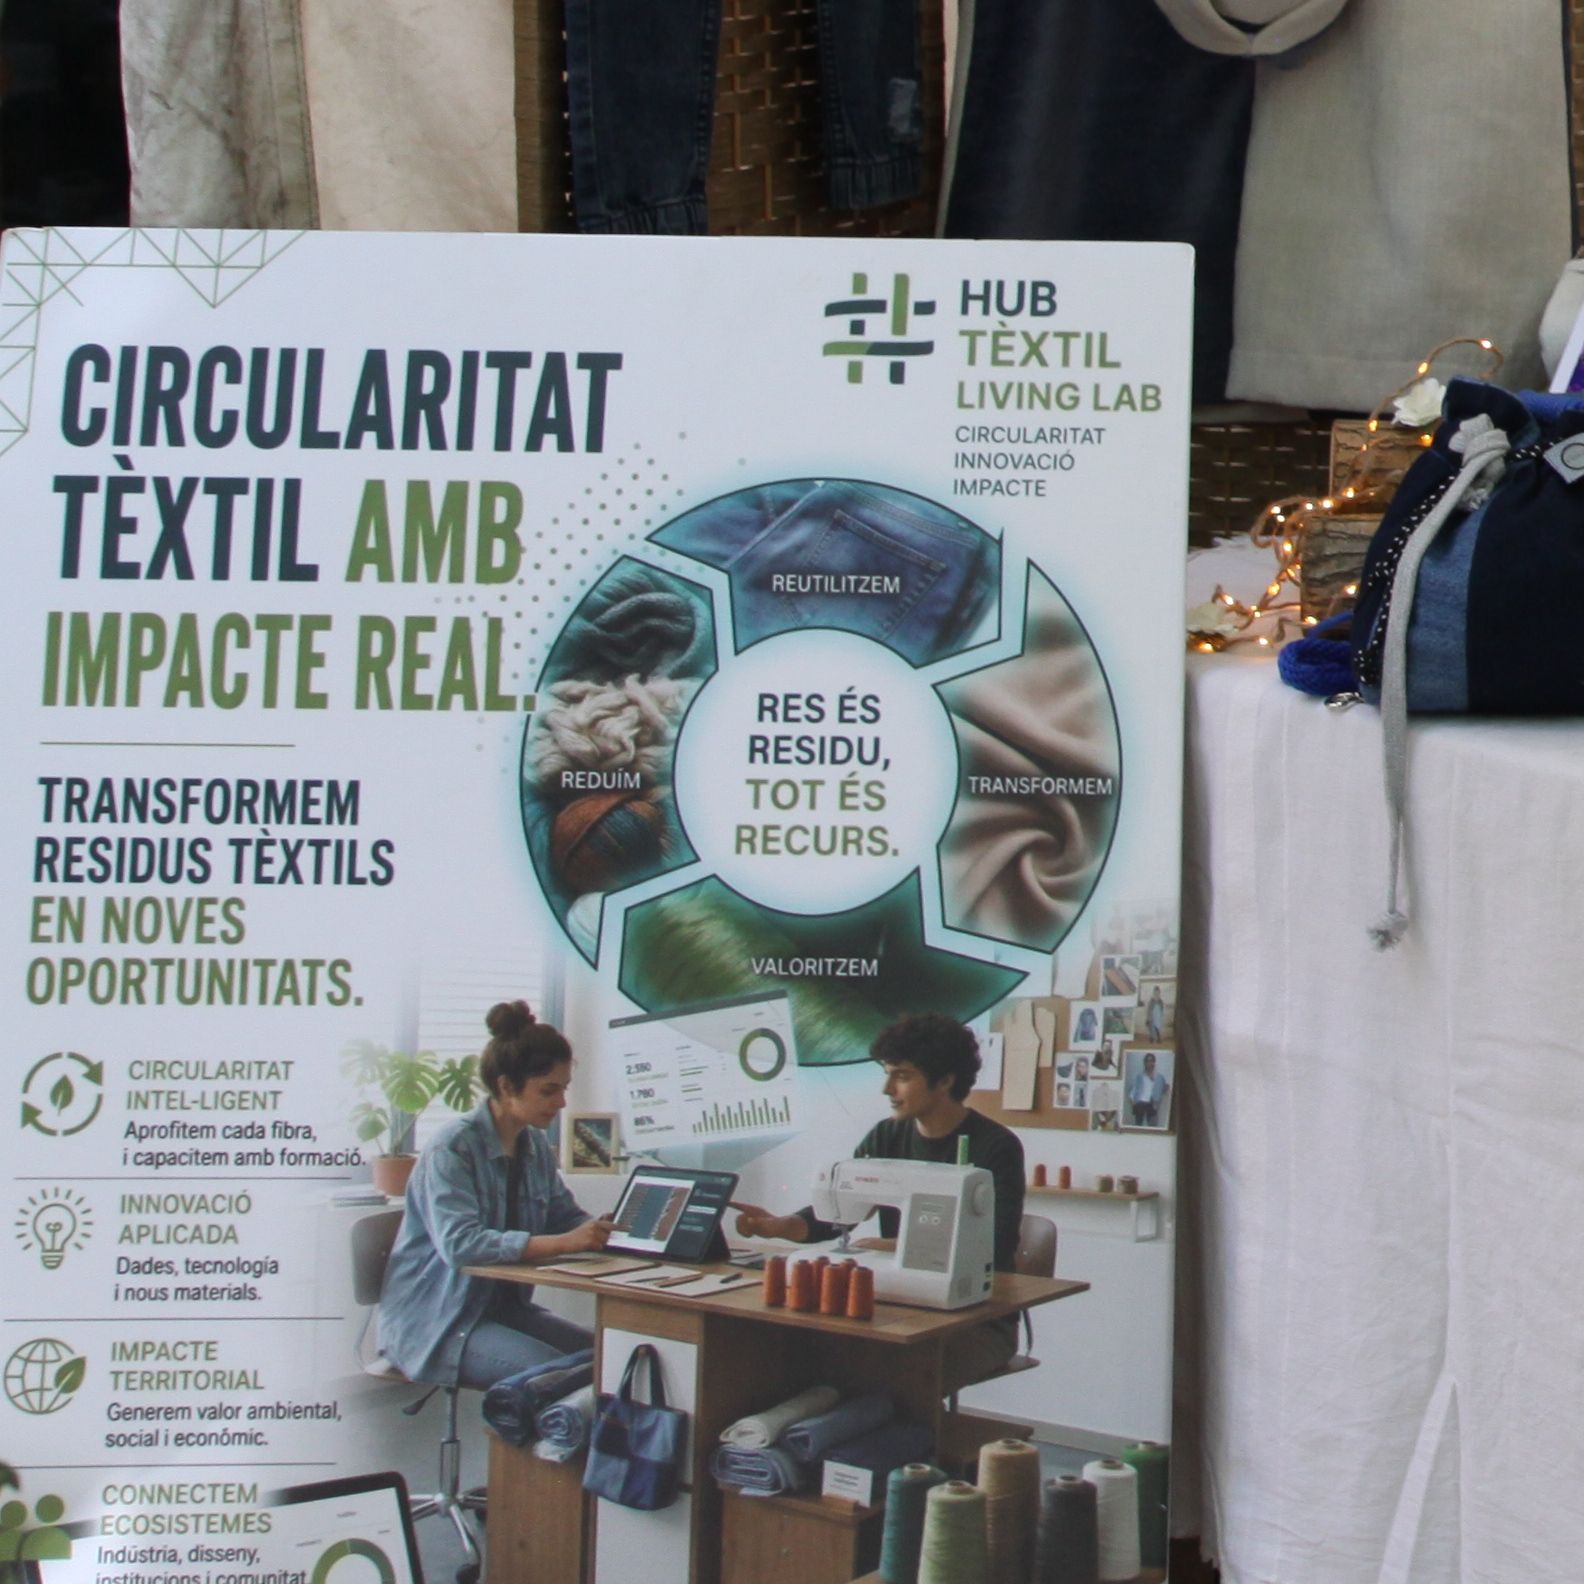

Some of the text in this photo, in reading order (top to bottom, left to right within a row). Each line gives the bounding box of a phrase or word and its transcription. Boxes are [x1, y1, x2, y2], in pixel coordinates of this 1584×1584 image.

[959, 280, 1058, 317] HUB
[957, 320, 1122, 369] TÈXTIL
[60, 343, 623, 453] CIRCULARITAT
[956, 381, 1162, 413] LIVING LAB
[954, 425, 1106, 446] CIRCULARITAT
[953, 448, 1075, 471] INNOVACIÓ
[952, 477, 1047, 498] IMPACTE
[52, 454, 524, 585] TÈXTIL AMB
[771, 573, 900, 595] REUTILITZEM
[41, 611, 536, 712] IMPACTE REAL.
[757, 686, 881, 725] RES ÉS
[747, 735, 892, 772] RESIDU,
[560, 767, 641, 790] REDUÍM
[746, 770, 886, 811] TOT ÉS
[968, 774, 1113, 797] TRANSFORMEM
[38, 776, 361, 826] TRANSFORMEM
[734, 824, 900, 858] RECURS.
[33, 828, 396, 886] RESIDUS TÈXTILS
[30, 896, 247, 945] EN NOVES
[751, 956, 879, 978] VALORITZEM
[25, 957, 364, 1007] OPORTUNITATS.
[127, 1059, 295, 1081] CIRCULARITAT
[124, 1120, 318, 1144] Aprofitem cada fibra,
[122, 1147, 367, 1169] i capacitem amb formació.
[119, 1190, 252, 1215] INNOVACIÓ
[118, 1224, 239, 1245] APLICADA
[116, 1256, 179, 1277] Dades,
[113, 1283, 262, 1302] i nous materials.
[111, 1340, 218, 1363] IMPACTE
[109, 1369, 265, 1392] TERRITORIAL
[106, 1400, 343, 1422] Generem valor ambiental,
[104, 1428, 159, 1448] social
[163, 1428, 169, 1446] i
[102, 1482, 258, 1506] CONNECTEM
[99, 1512, 272, 1536] ECOSISTEMES
[187, 1545, 261, 1566] disseny,
